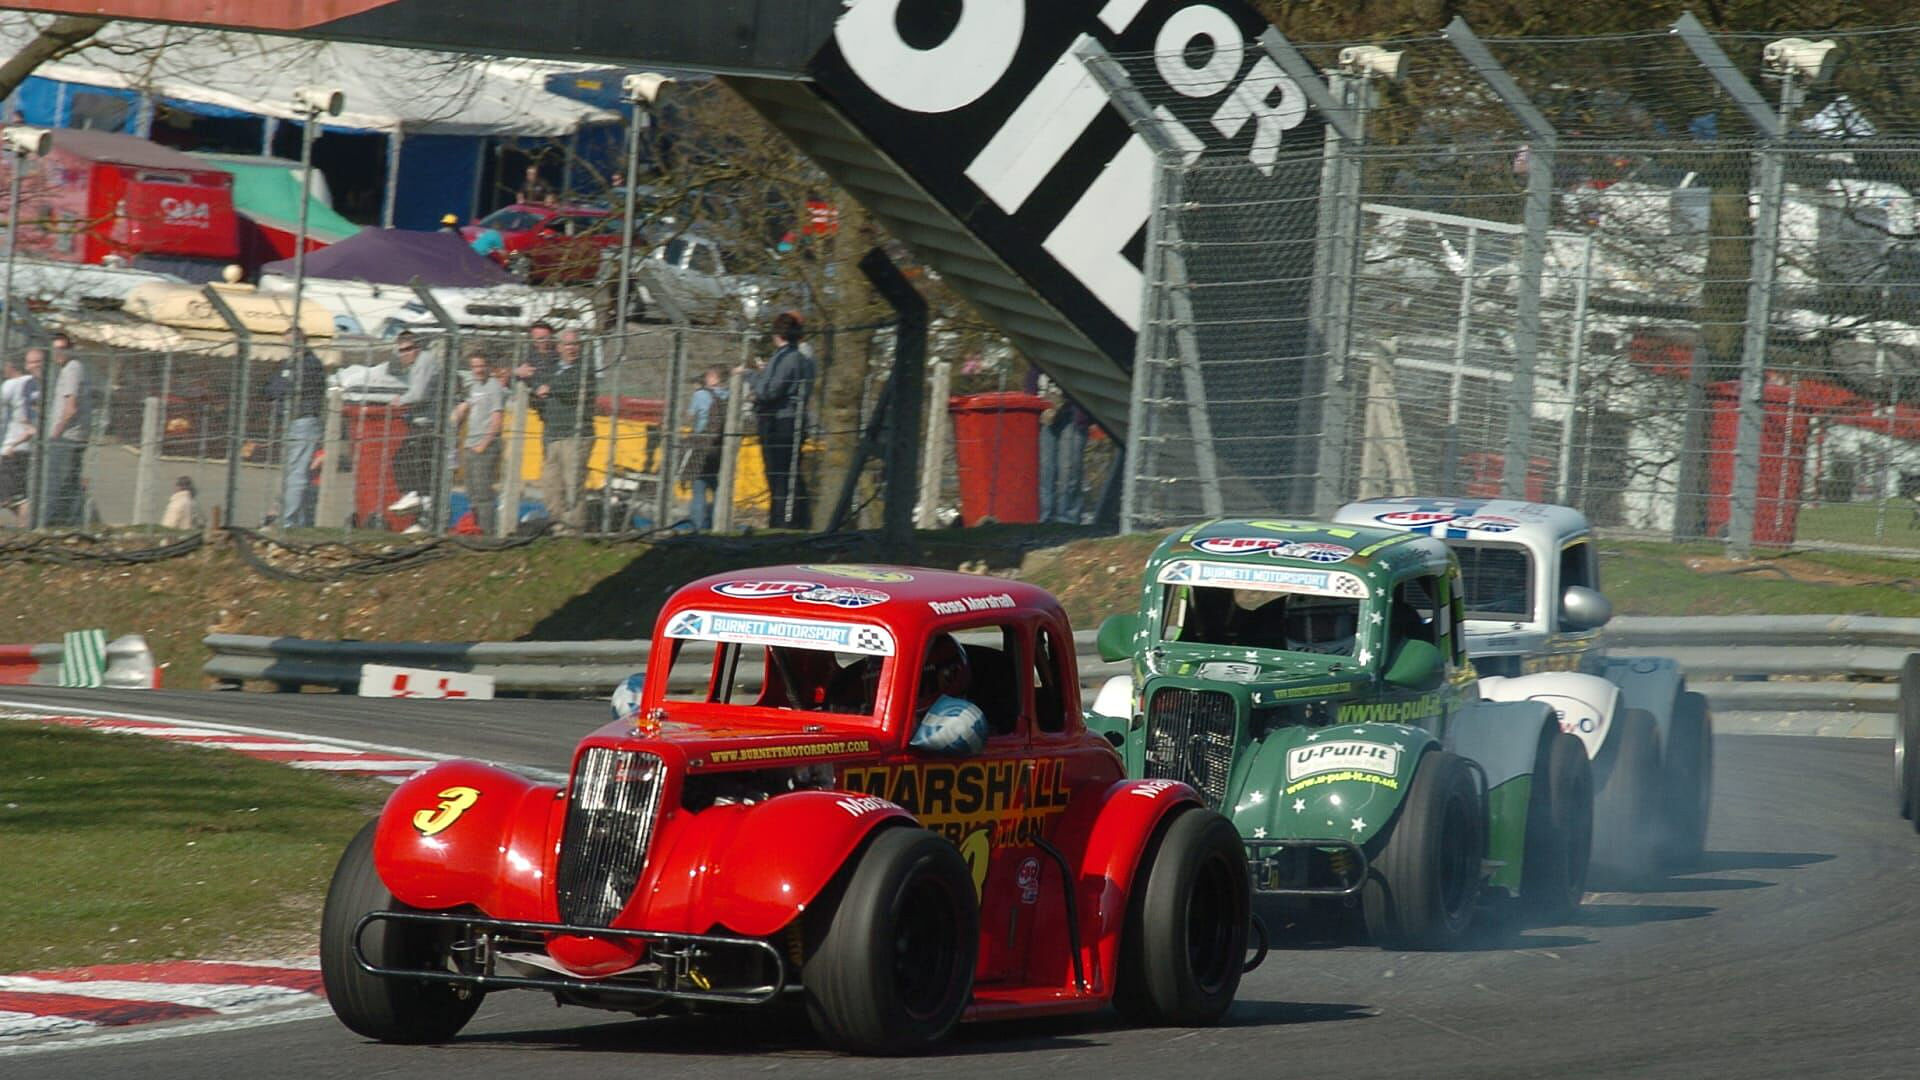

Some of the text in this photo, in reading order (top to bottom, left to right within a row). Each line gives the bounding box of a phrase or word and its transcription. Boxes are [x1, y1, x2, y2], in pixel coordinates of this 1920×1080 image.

[927, 601, 967, 615] Ross
[713, 617, 765, 635] BURNETT
[767, 622, 848, 642] MOTORSPORT
[711, 741, 869, 763] WWW.BURNETTMOTORSPORT.COM
[1297, 745, 1388, 763] U-Pull-It
[843, 757, 1071, 821] MARSHALL
[412, 786, 481, 836] 3
